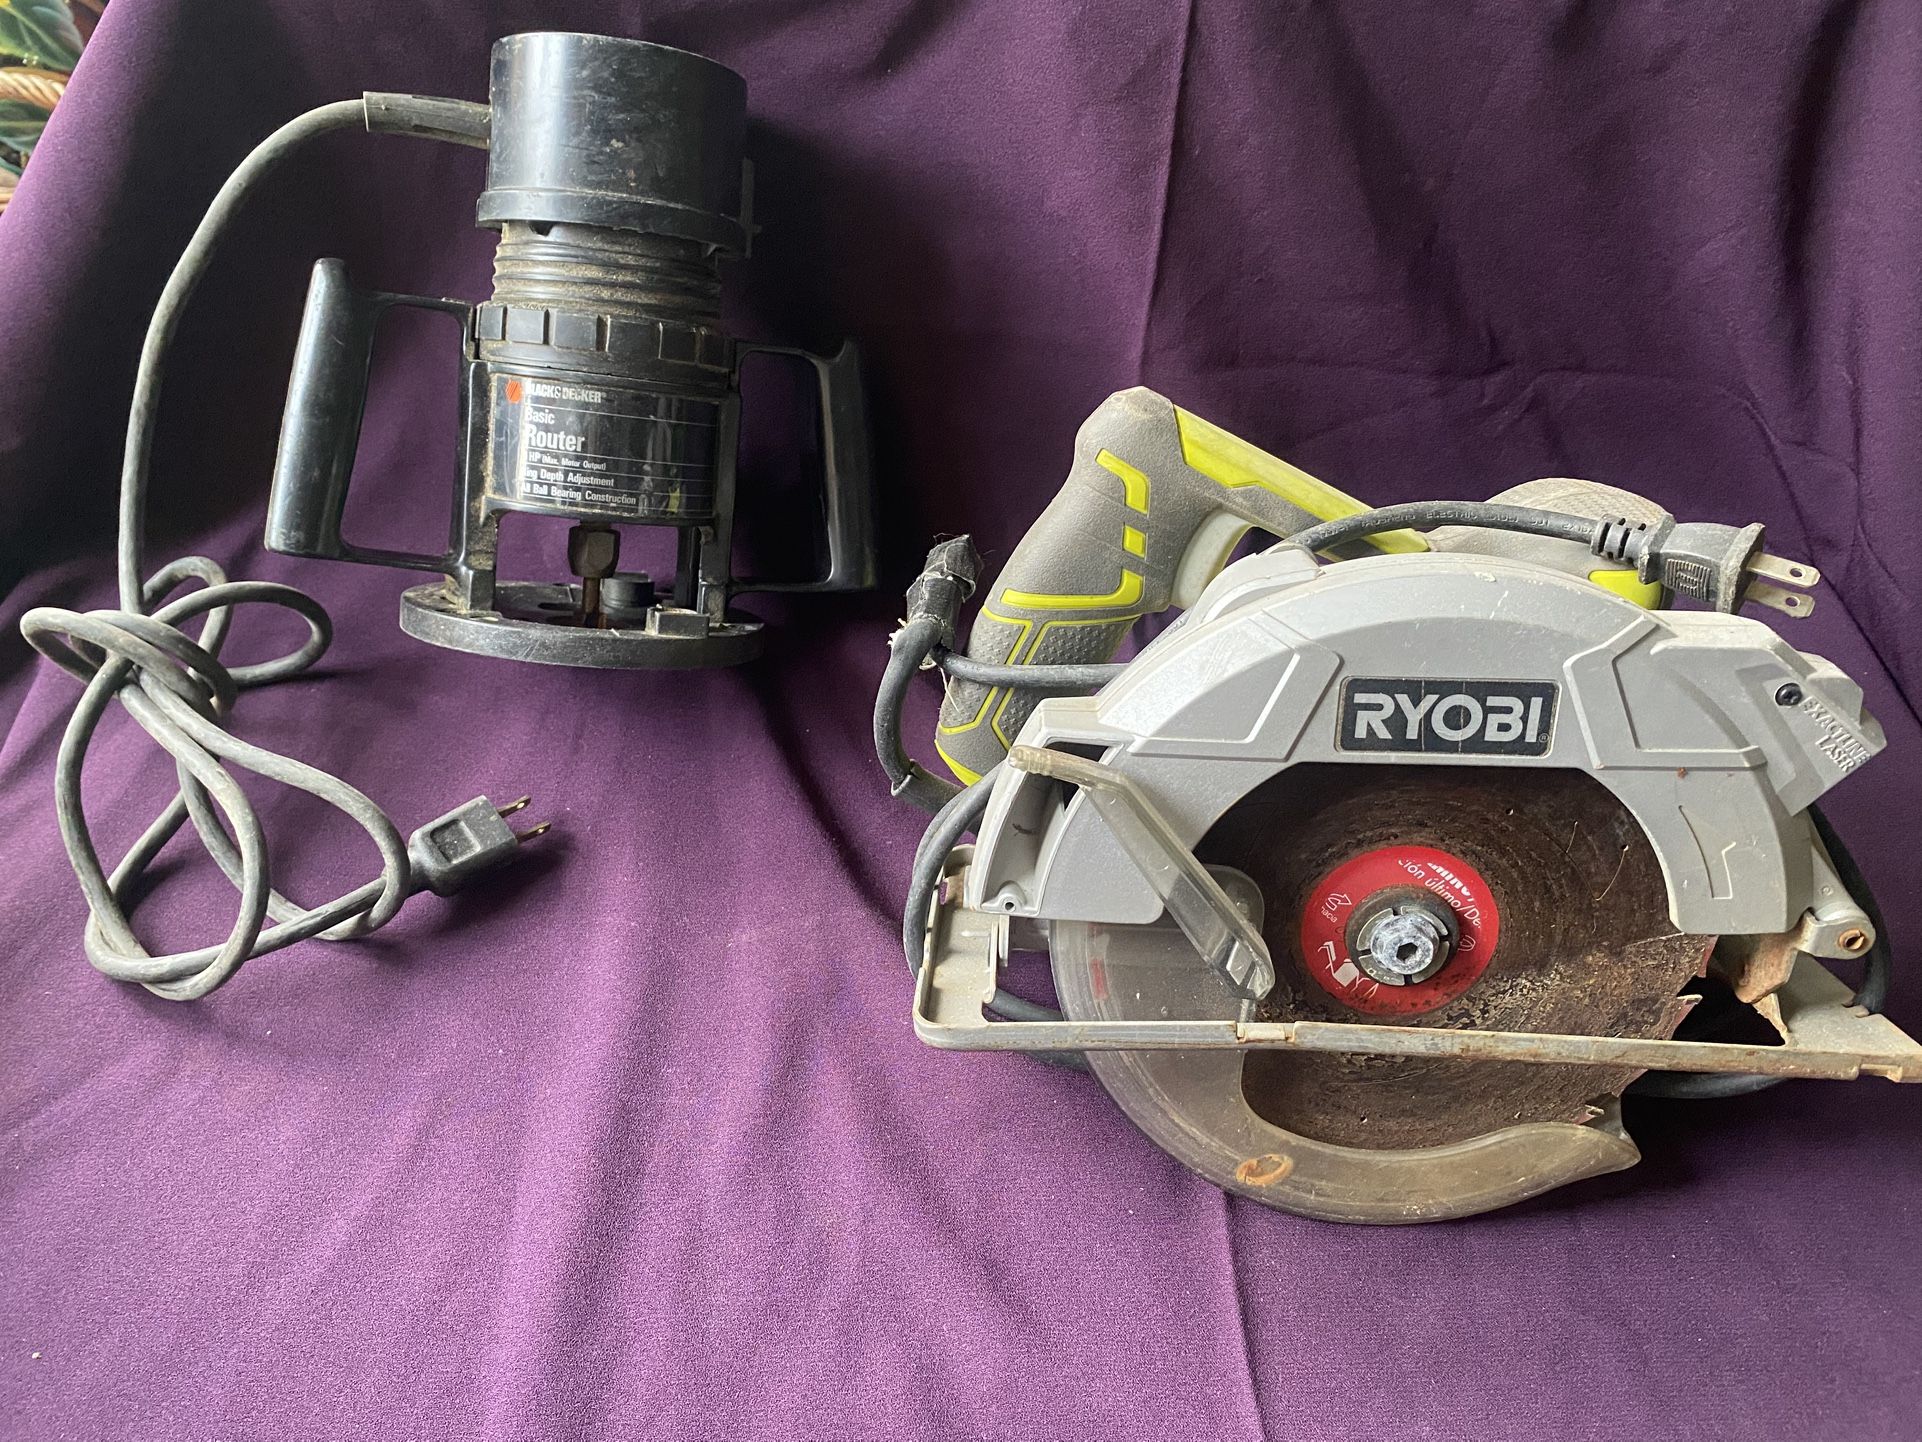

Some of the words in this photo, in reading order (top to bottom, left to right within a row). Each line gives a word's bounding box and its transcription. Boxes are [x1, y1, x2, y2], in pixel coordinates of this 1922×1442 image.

[525, 407, 555, 424] Basic
[525, 424, 586, 452] Router
[529, 451, 541, 462] HP
[541, 469, 564, 482] Depth
[567, 472, 615, 486] Adjustment
[533, 483, 548, 495] Ball
[551, 486, 582, 500] Bearing
[585, 490, 636, 504] Construction
[1815, 734, 1857, 773] LASER
